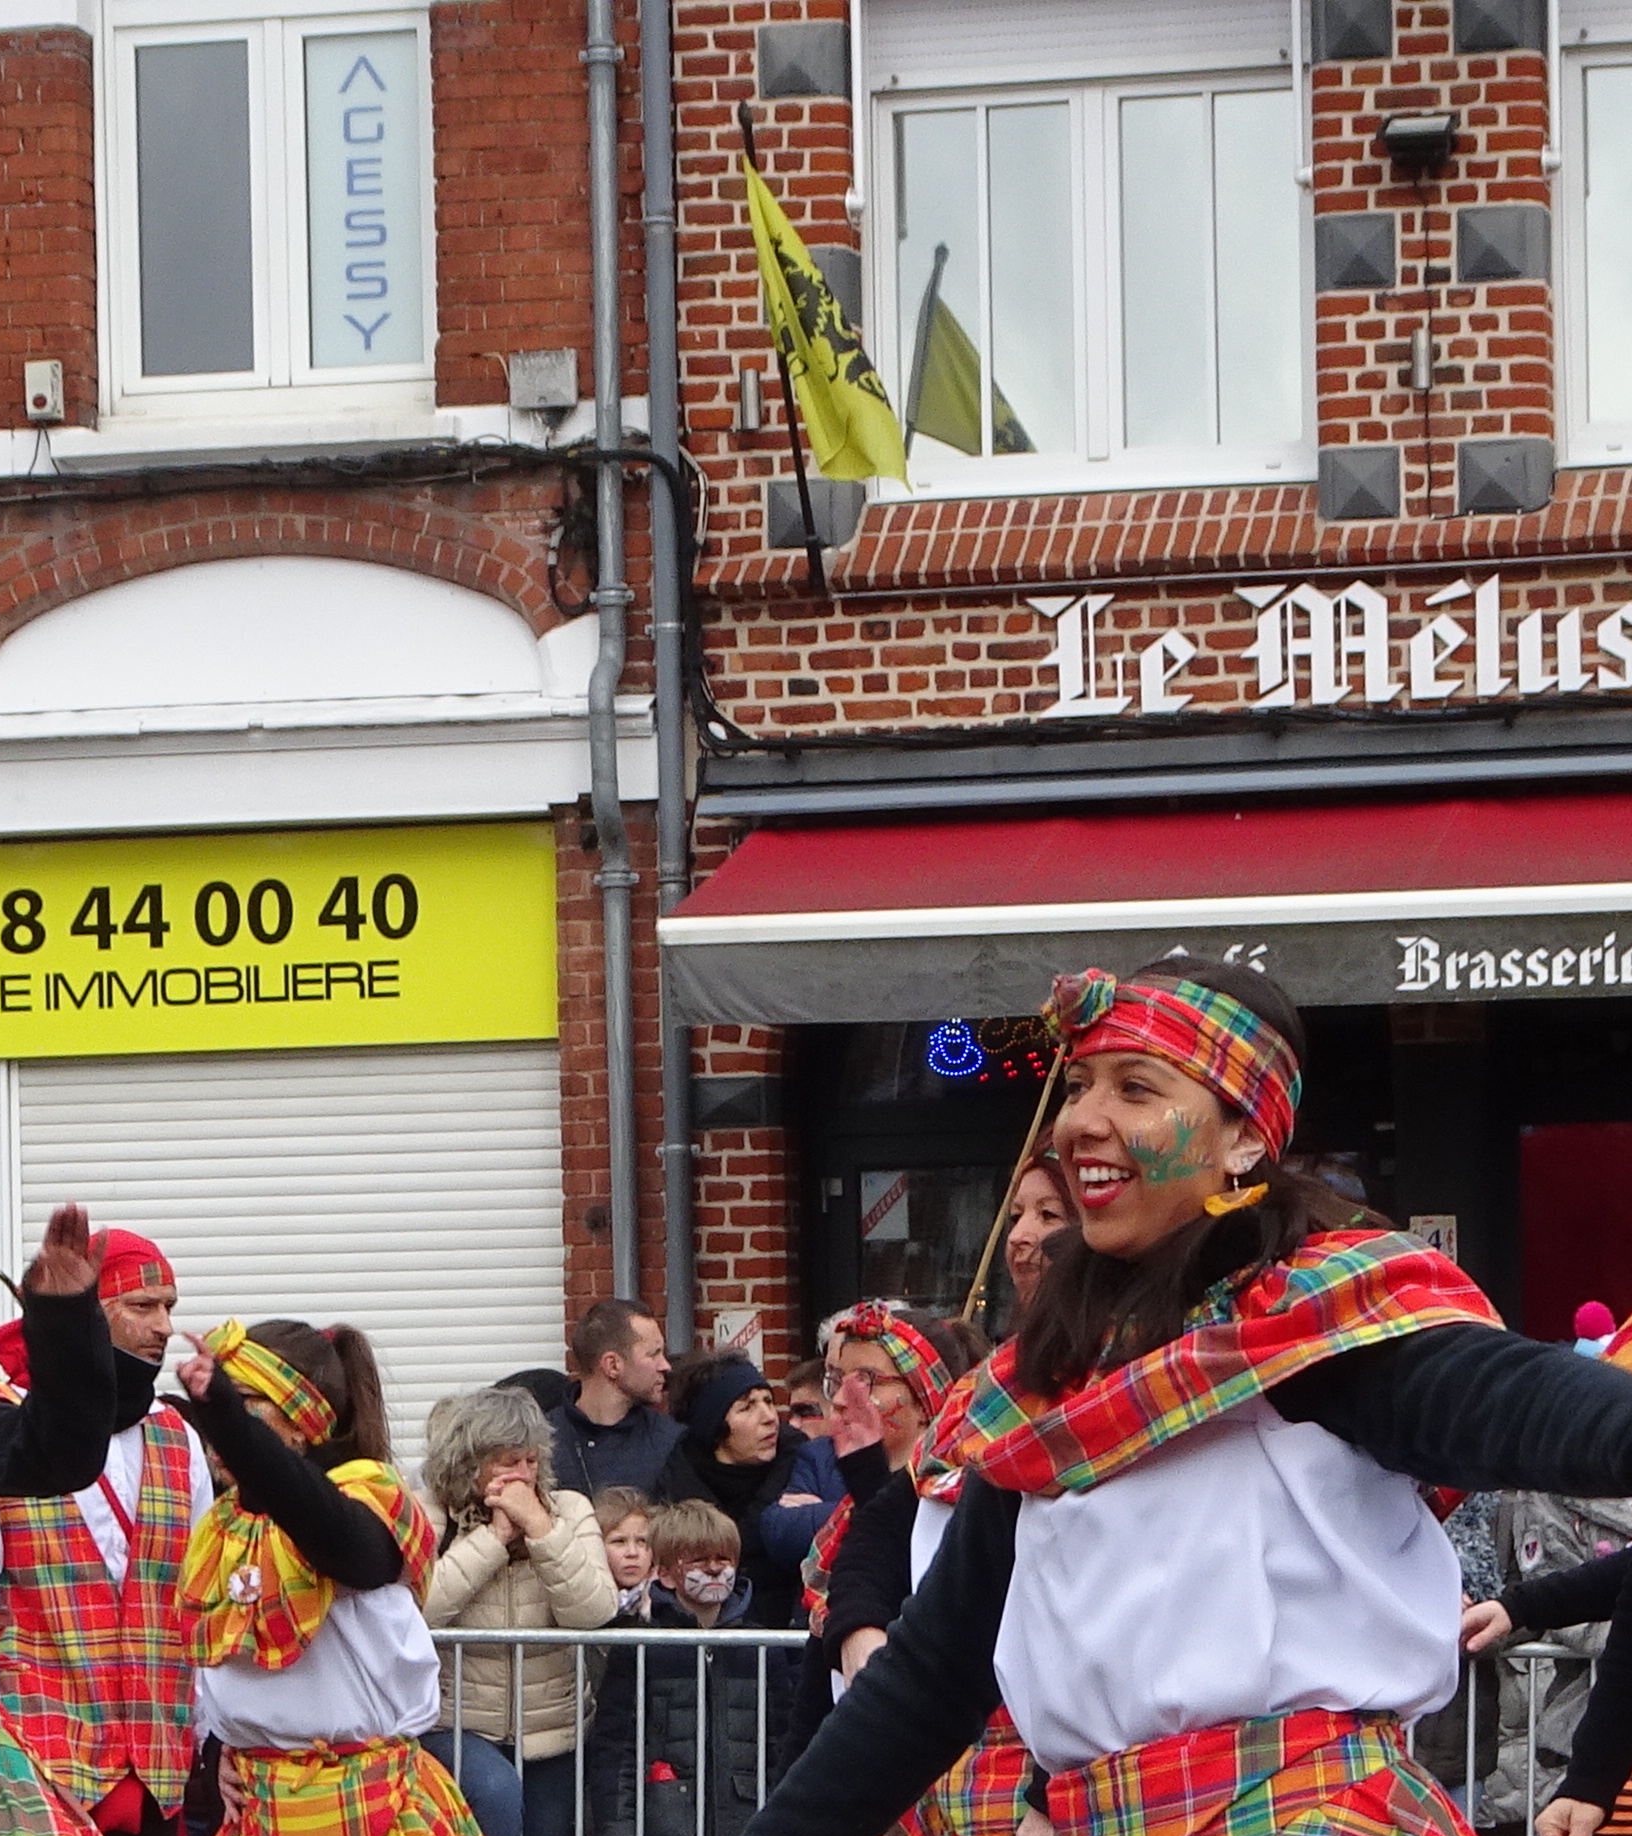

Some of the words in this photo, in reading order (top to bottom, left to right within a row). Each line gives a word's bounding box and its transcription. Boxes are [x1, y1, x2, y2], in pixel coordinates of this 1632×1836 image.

[338, 55, 391, 351] AGESSY
[1028, 593, 1197, 719] Le
[70, 884, 170, 950] 44
[194, 879, 294, 946] 00
[318, 874, 419, 940] 40
[44, 960, 401, 1011] IMMOBILIERE
